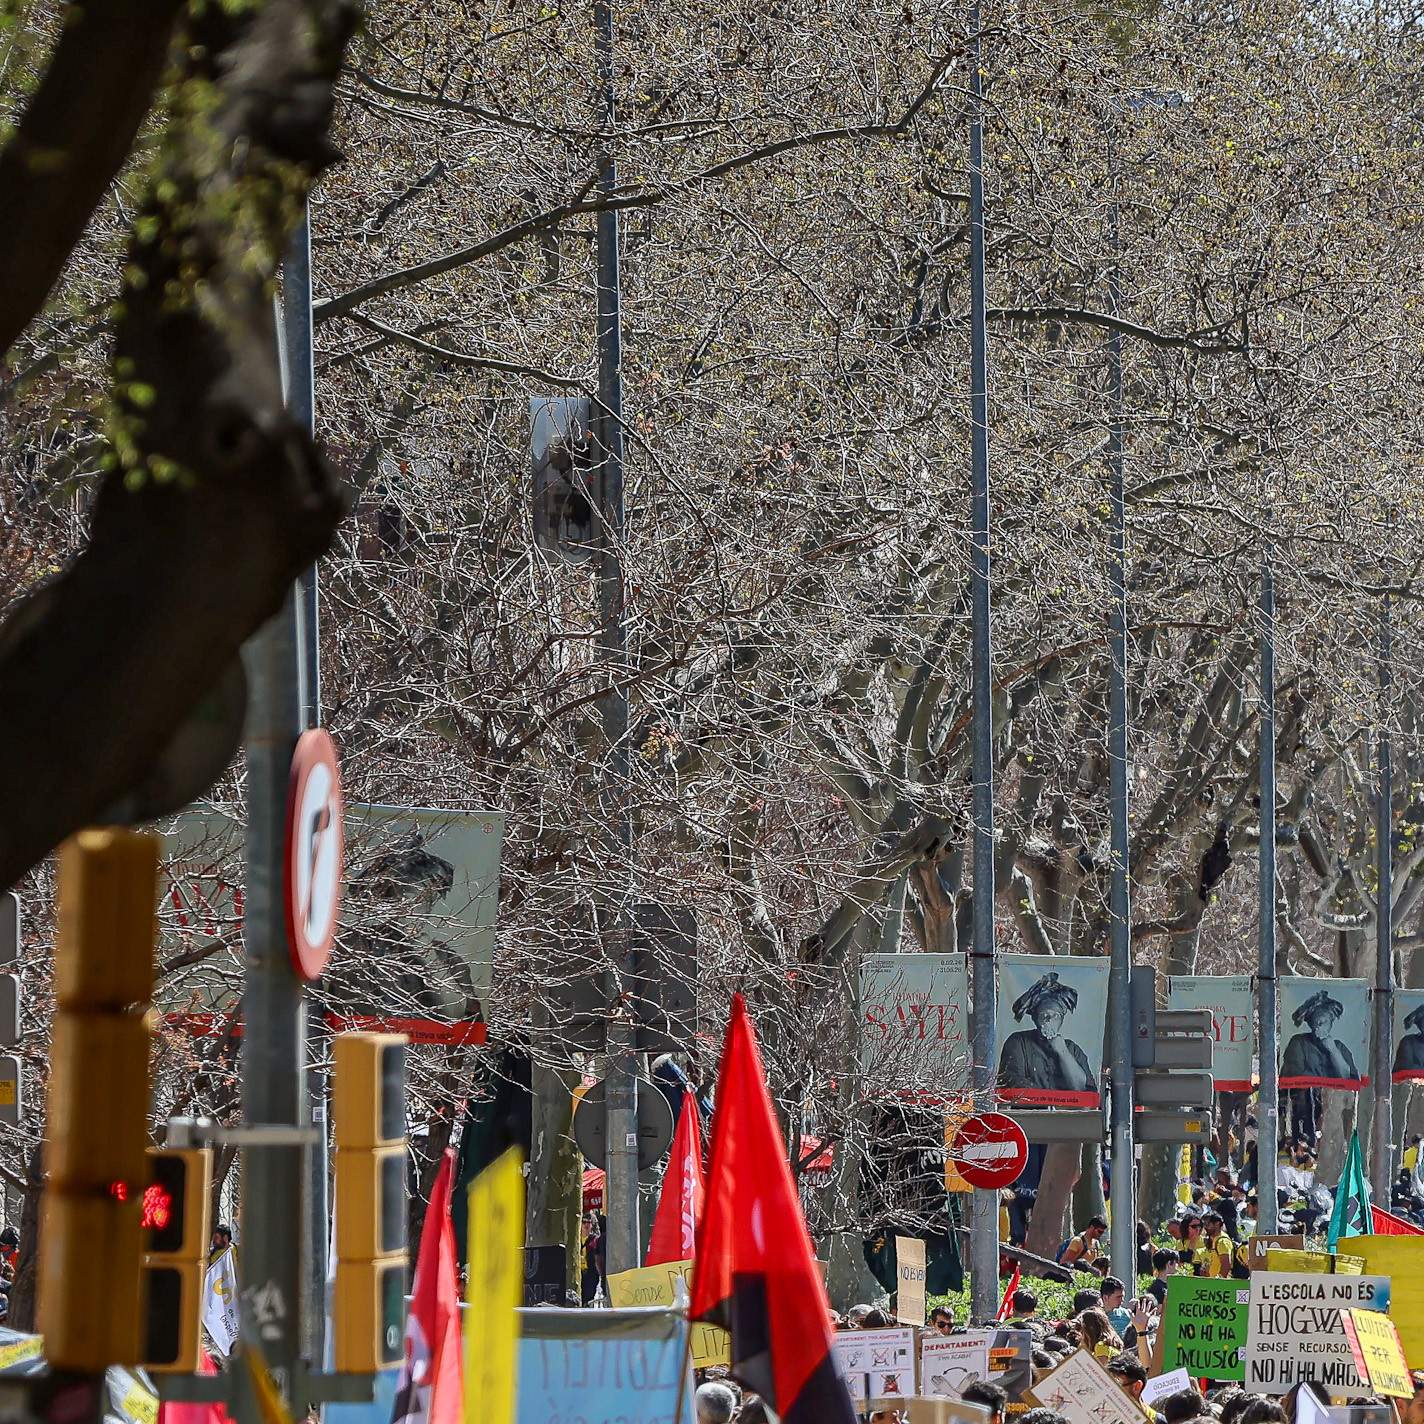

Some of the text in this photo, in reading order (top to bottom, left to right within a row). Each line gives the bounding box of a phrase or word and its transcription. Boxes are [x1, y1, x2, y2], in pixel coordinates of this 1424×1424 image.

[863, 1003, 962, 1041] SAYE
[1193, 1289, 1230, 1304] SENSE
[1261, 1280, 1375, 1301] L'ESCOLA NO ÉS
[1178, 1304, 1237, 1322] RECURSOS
[1256, 1303, 1346, 1336] HOGWA
[1178, 1323, 1195, 1340] NO
[1218, 1326, 1236, 1340] HA
[1256, 1342, 1289, 1353] SENSE
[1252, 1358, 1275, 1384] NO
[1297, 1361, 1316, 1385] HA
[1322, 1357, 1371, 1388] MÀG
